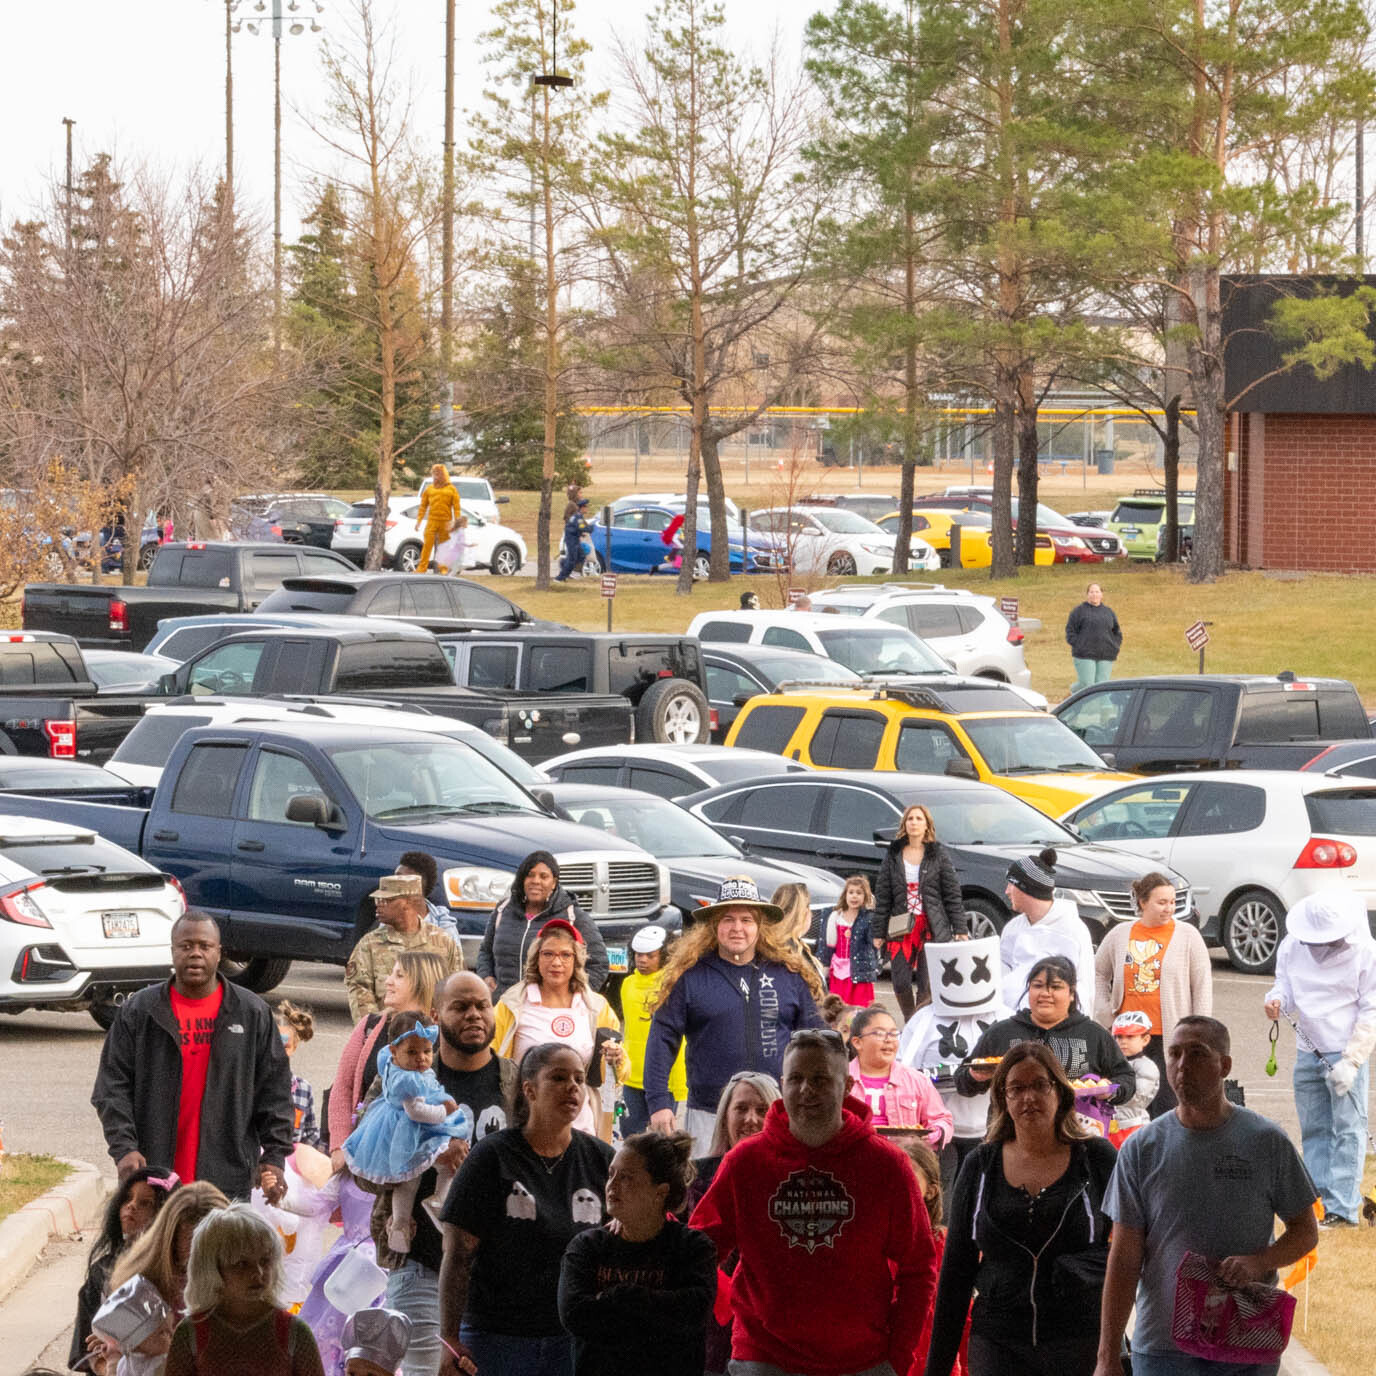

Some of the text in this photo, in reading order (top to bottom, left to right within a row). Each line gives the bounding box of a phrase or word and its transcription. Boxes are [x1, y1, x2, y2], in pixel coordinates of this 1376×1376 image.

[317, 881, 342, 890] 1500
[758, 989, 780, 1058] COWBOYS
[774, 1200, 849, 1216] CHAMPIONS
